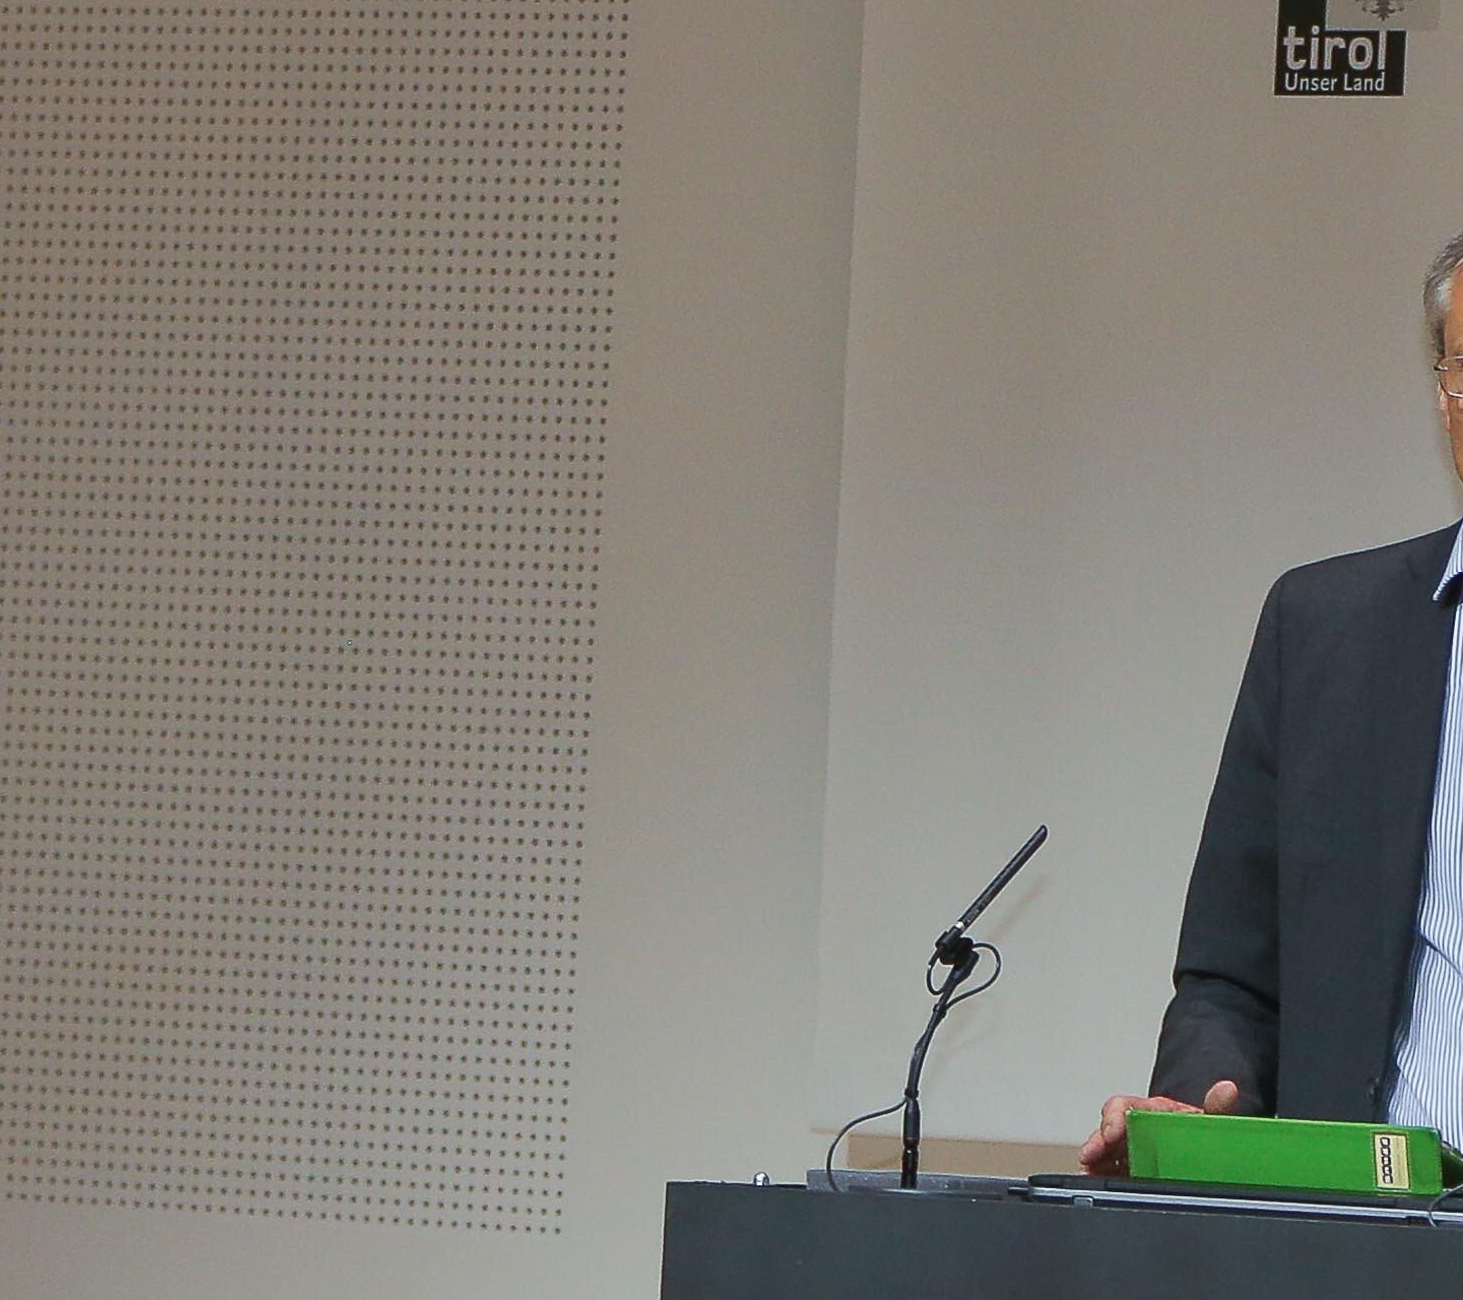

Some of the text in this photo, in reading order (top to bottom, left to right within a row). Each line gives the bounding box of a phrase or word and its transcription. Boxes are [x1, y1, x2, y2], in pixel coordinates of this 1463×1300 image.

[1283, 25, 1387, 70] tirol
[1284, 71, 1385, 92] Unser Land
